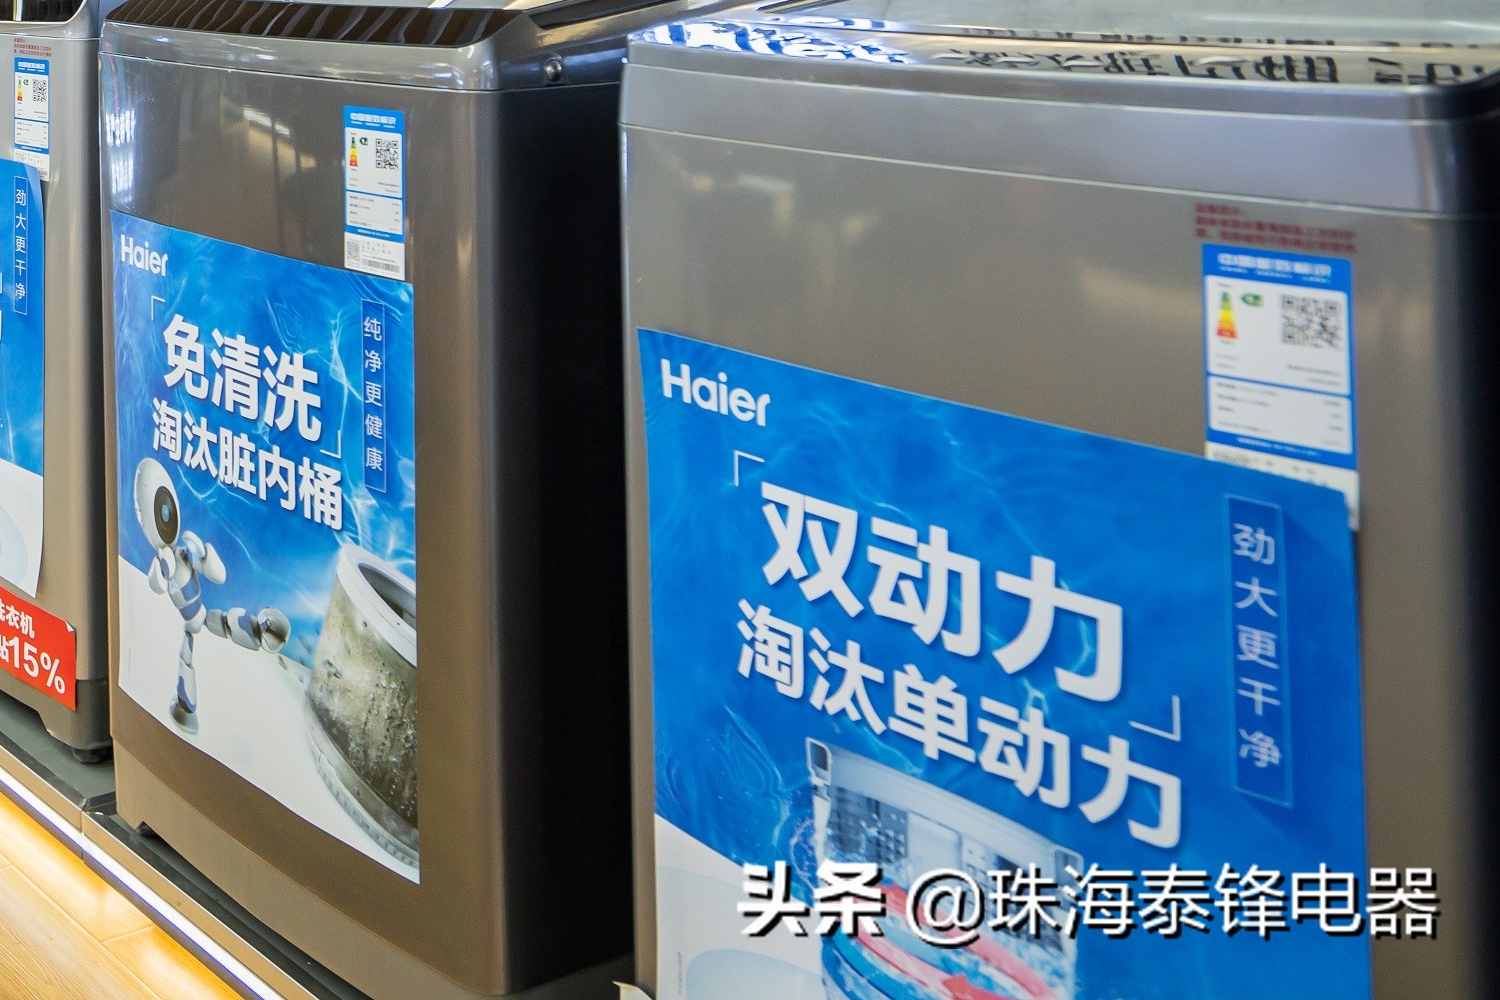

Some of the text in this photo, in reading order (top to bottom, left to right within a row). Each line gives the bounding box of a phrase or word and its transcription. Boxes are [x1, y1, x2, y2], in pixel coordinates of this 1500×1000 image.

[14, 187, 27, 300] 劲大更干净
[120, 234, 169, 278] Haier
[163, 314, 322, 442] 免清洗
[362, 316, 384, 473] 纯净更健康
[659, 357, 771, 427] Haier
[152, 396, 344, 532] 淘汰脏内桶
[760, 481, 1124, 704] 双动力
[1231, 522, 1284, 770] 劲大更干净
[736, 599, 1183, 851] 淘汰单动力
